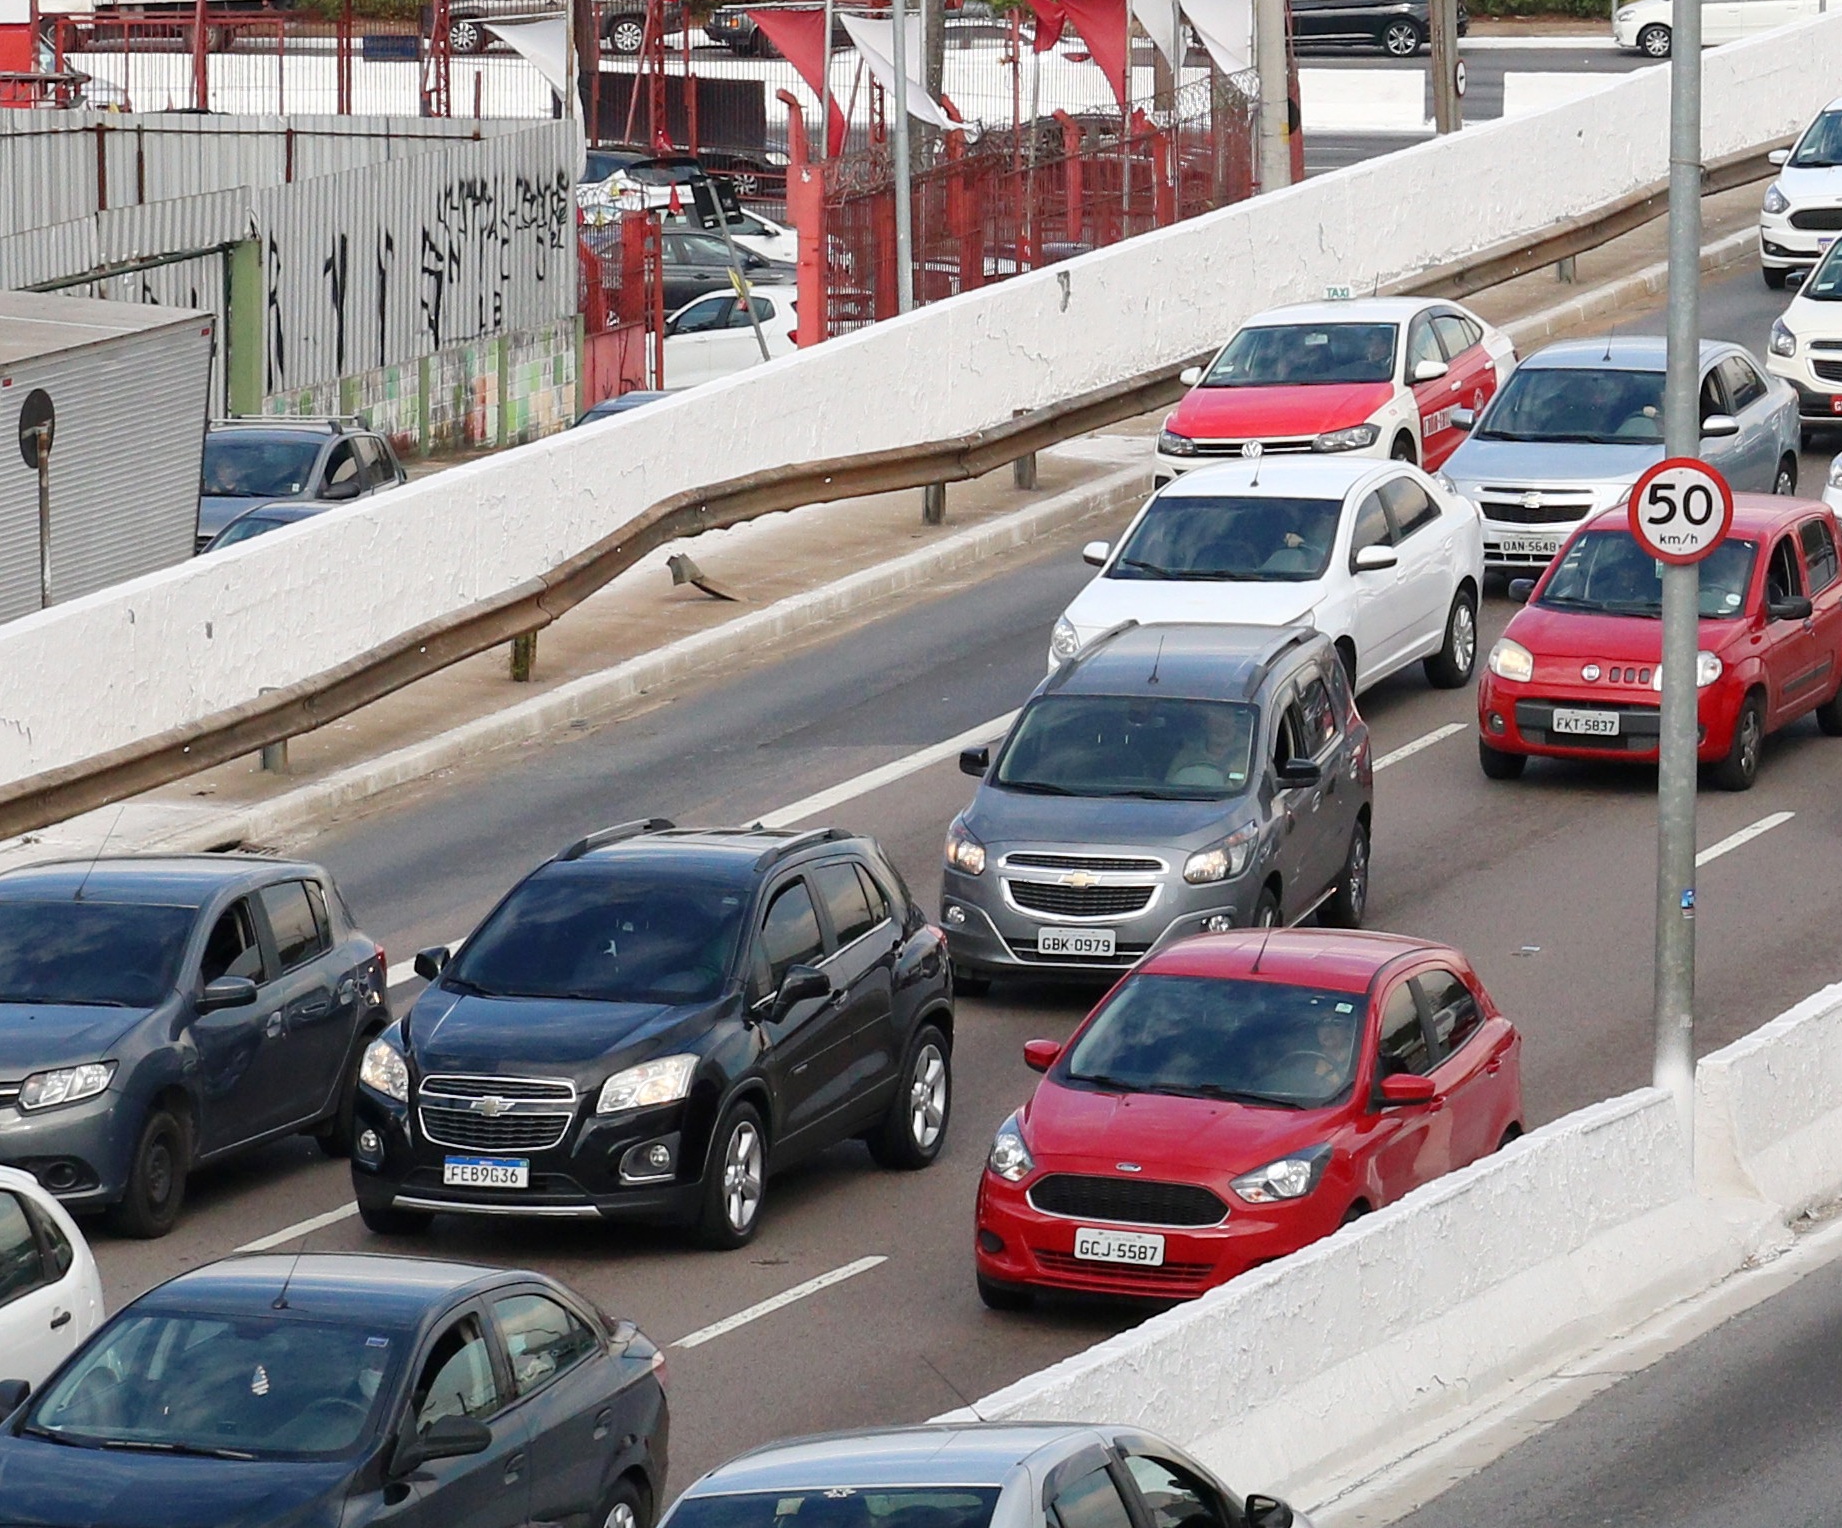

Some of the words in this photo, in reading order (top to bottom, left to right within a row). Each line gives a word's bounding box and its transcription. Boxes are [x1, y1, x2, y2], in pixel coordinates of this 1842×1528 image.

[1326, 287, 1350, 298] TAXI
[1648, 483, 1713, 526] 50
[1660, 534, 1698, 545] km/h
[451, 1167, 519, 1184] FEB9G36
